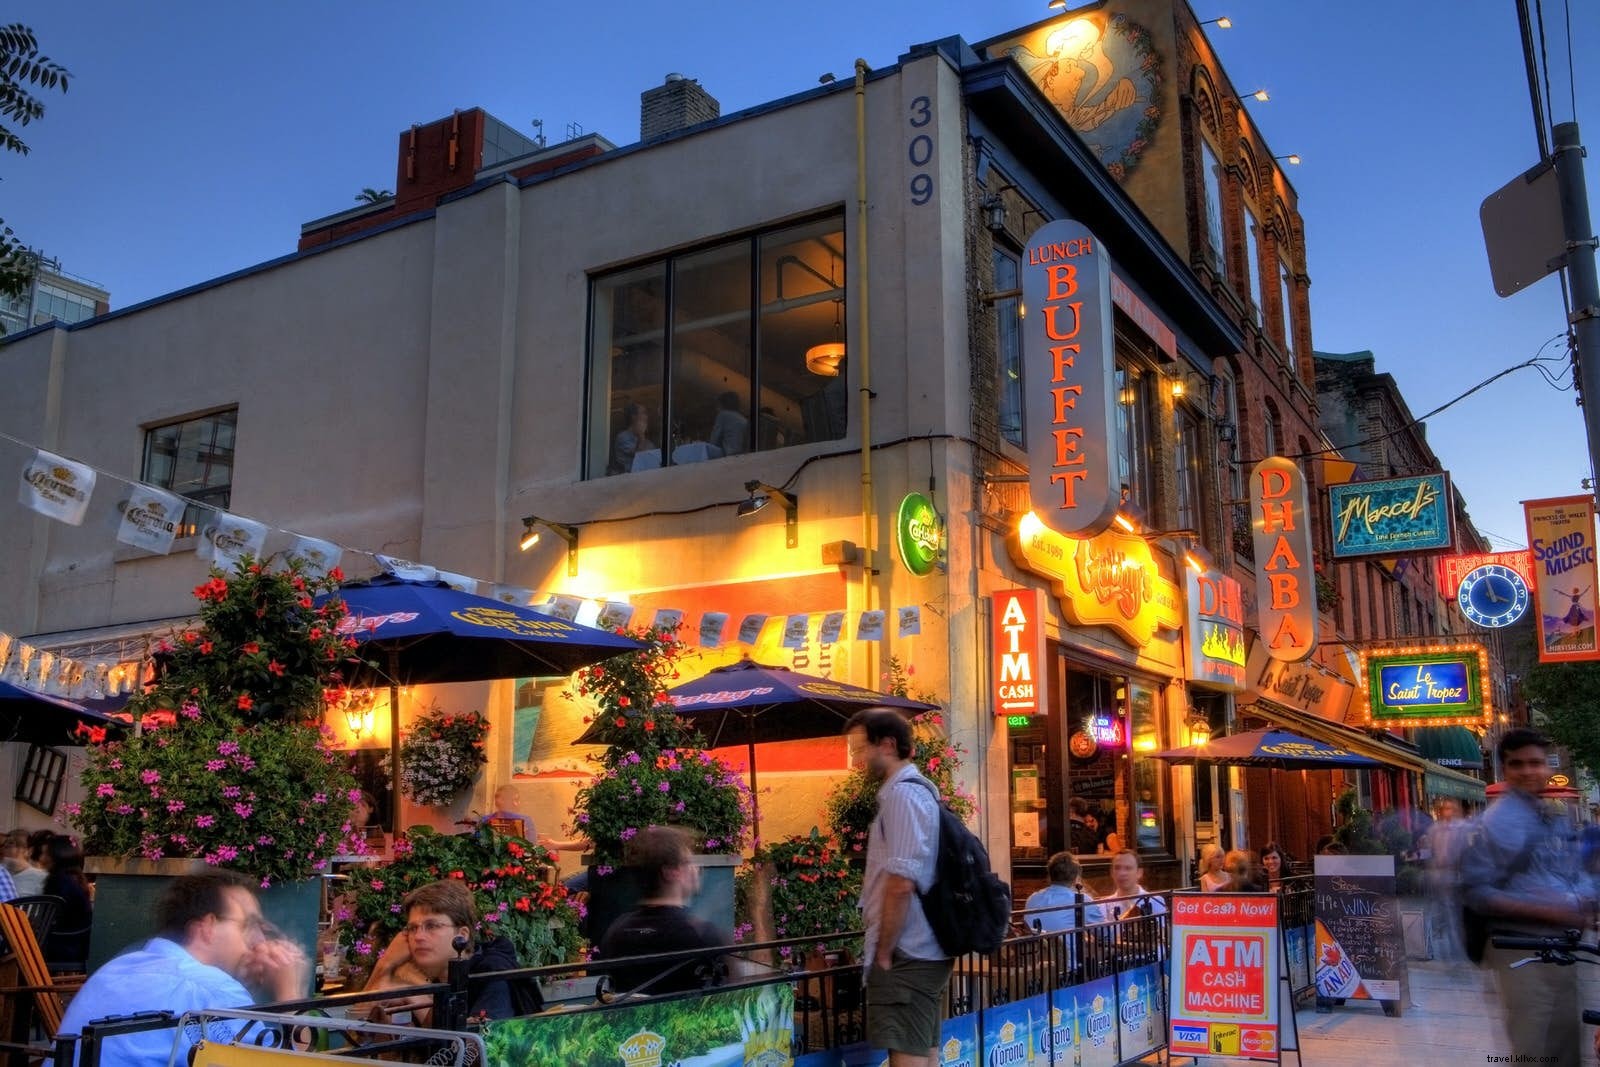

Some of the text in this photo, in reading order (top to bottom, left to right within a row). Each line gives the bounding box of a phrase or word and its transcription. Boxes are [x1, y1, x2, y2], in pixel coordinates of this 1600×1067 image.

[909, 96, 933, 206] 309
[1029, 237, 1092, 266] LUNCH
[1042, 264, 1088, 510] BUFFET
[1337, 481, 1439, 542] Marcel's
[1533, 531, 1584, 560] SOUND
[1259, 468, 1304, 650] DHABA
[1545, 546, 1593, 576] MUSIC
[1000, 597, 1027, 682] ATM
[1417, 665, 1431, 683] Le
[999, 685, 1034, 699] CASH
[1387, 681, 1462, 703] Saint Tropez
[1438, 758, 1463, 766] FENICE
[1177, 902, 1274, 916] Get Cash Now!
[1340, 898, 1390, 916] WINGS
[1189, 939, 1262, 968] ATM
[1202, 972, 1246, 987] CASH
[1120, 1000, 1144, 1026] Corona
[1188, 992, 1260, 1009] MACHINE
[1087, 1012, 1111, 1039] Corona
[1179, 1032, 1201, 1042] VISA
